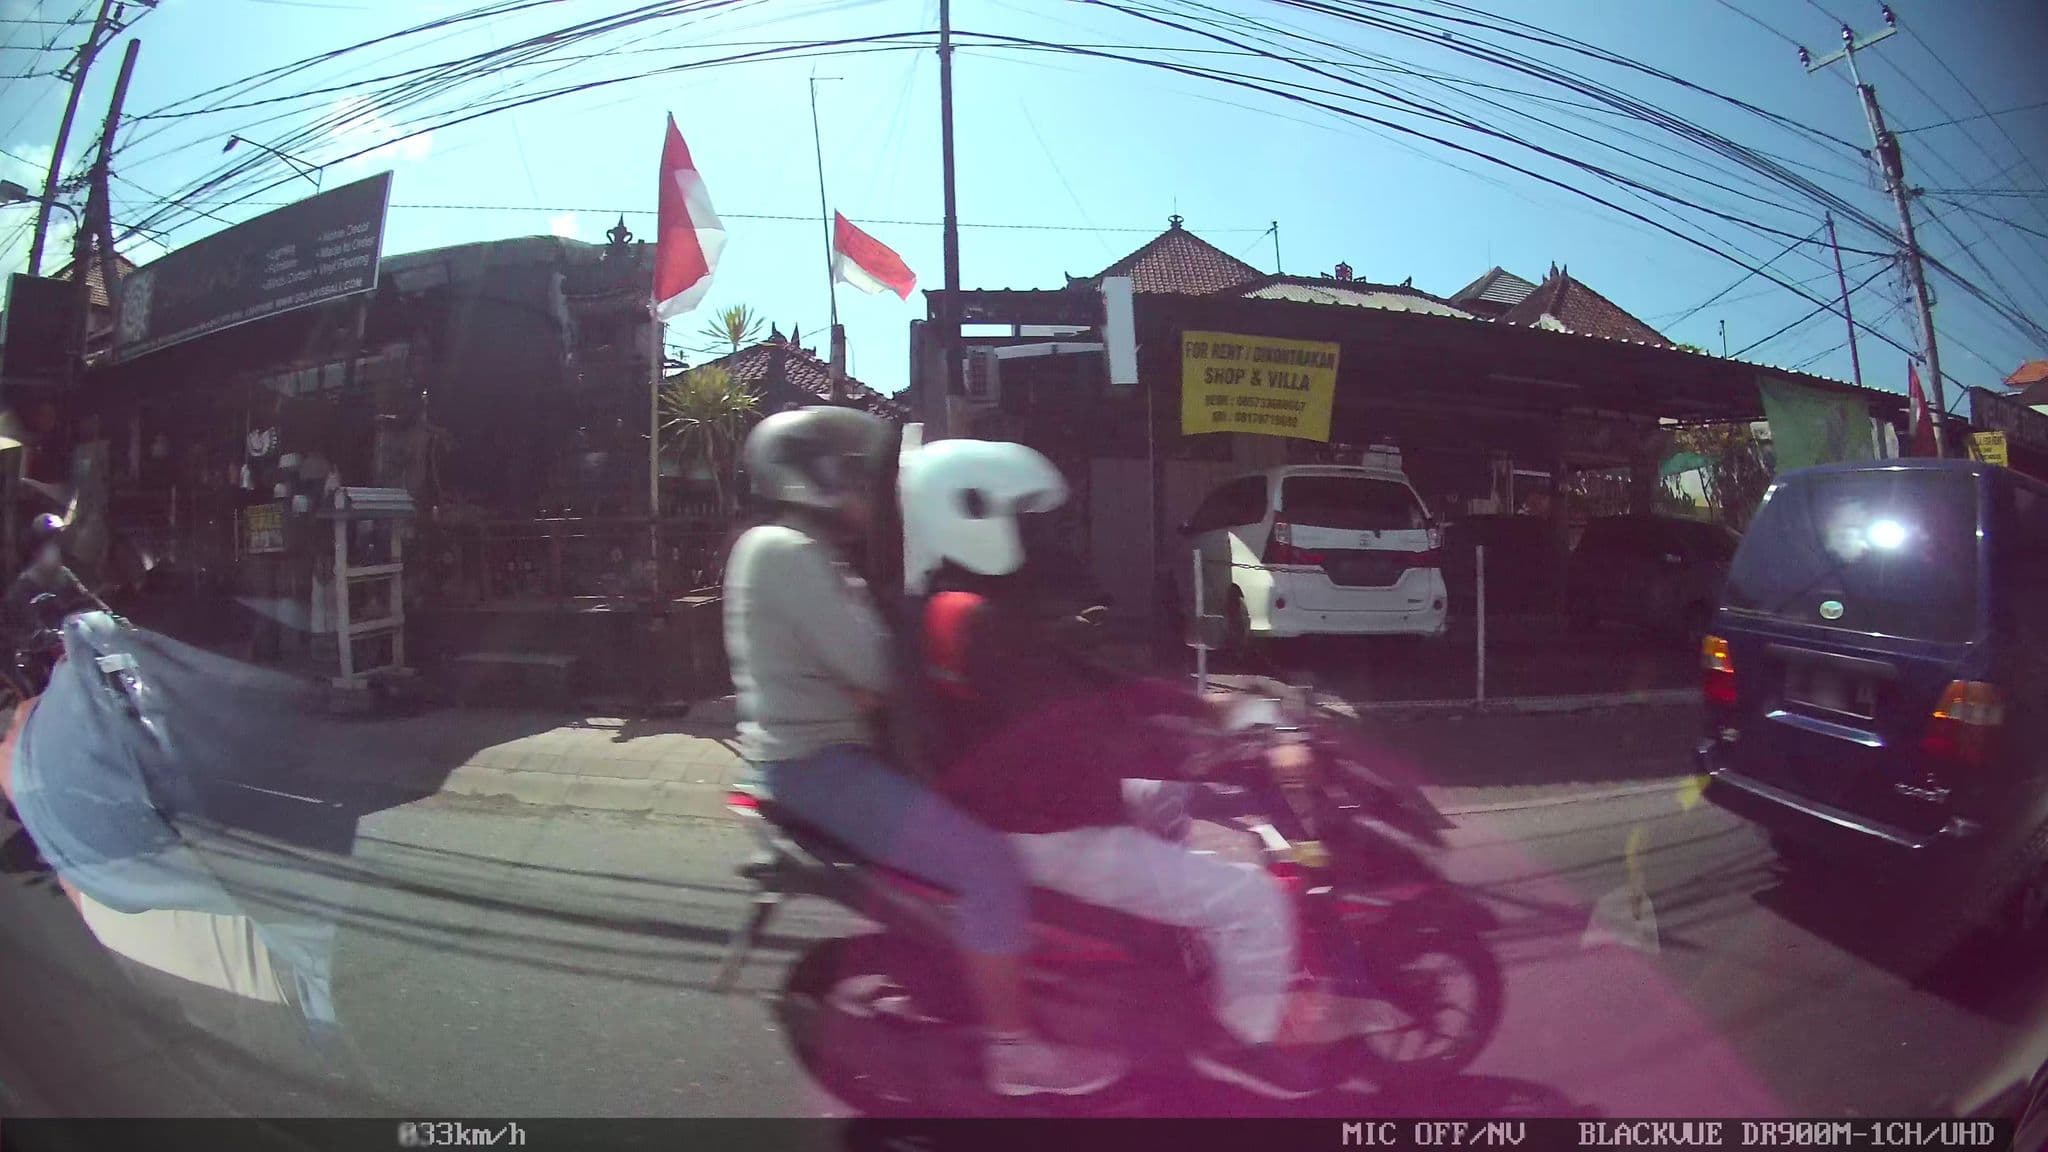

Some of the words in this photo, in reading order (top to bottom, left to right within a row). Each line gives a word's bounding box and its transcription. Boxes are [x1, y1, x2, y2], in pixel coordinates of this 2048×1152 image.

[1184, 341, 1208, 359] FOR
[1211, 343, 1245, 361] RENT
[1204, 367, 1245, 385] SHOP
[1251, 370, 1261, 386] &
[1268, 370, 1311, 391] VILLA
